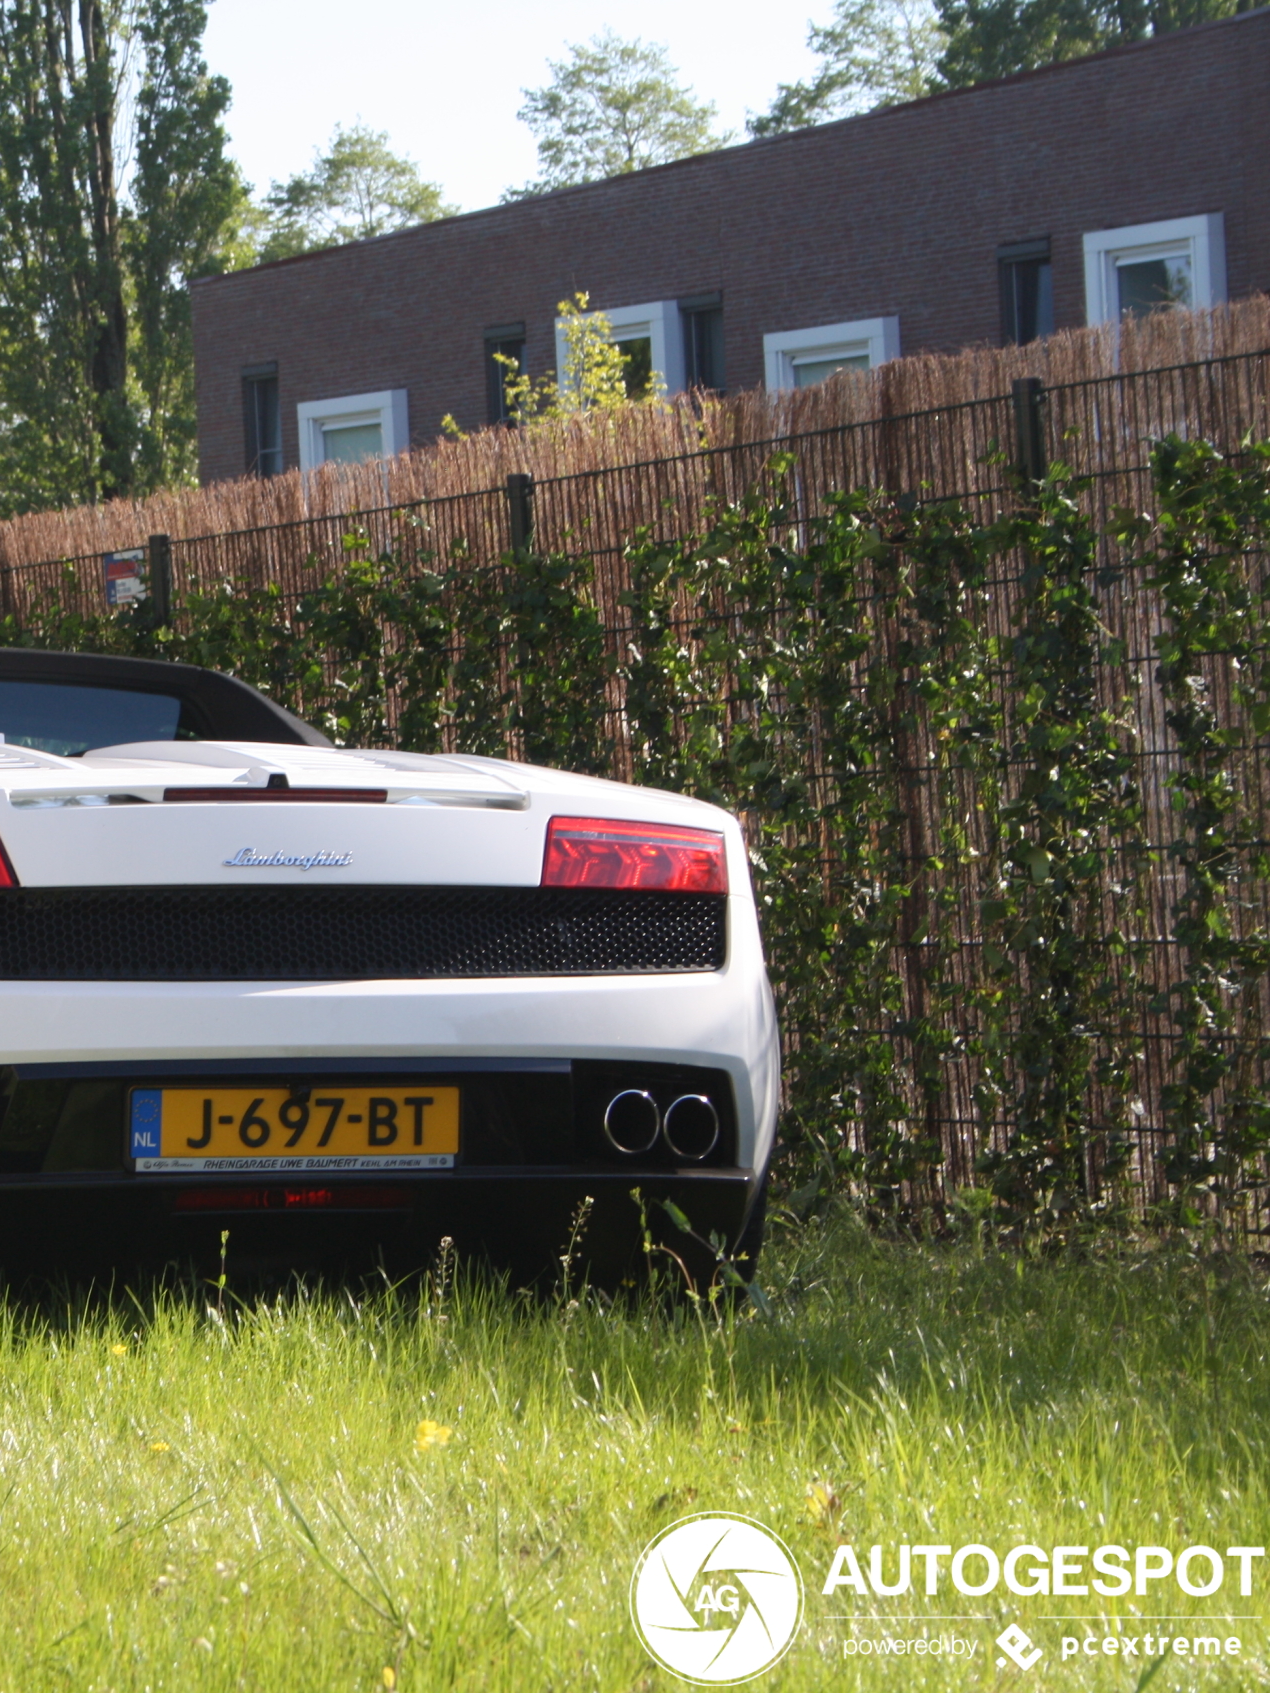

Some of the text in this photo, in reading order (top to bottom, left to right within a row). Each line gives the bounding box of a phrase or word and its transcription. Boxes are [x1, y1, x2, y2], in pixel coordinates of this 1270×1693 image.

[222, 847, 354, 871] Lamborghini
[186, 1096, 434, 1149] J-697-BT
[133, 1131, 157, 1148] NL
[203, 1157, 359, 1170] RHEINGARAGE UWE BAUMERT
[360, 1159, 381, 1168] KEHL
